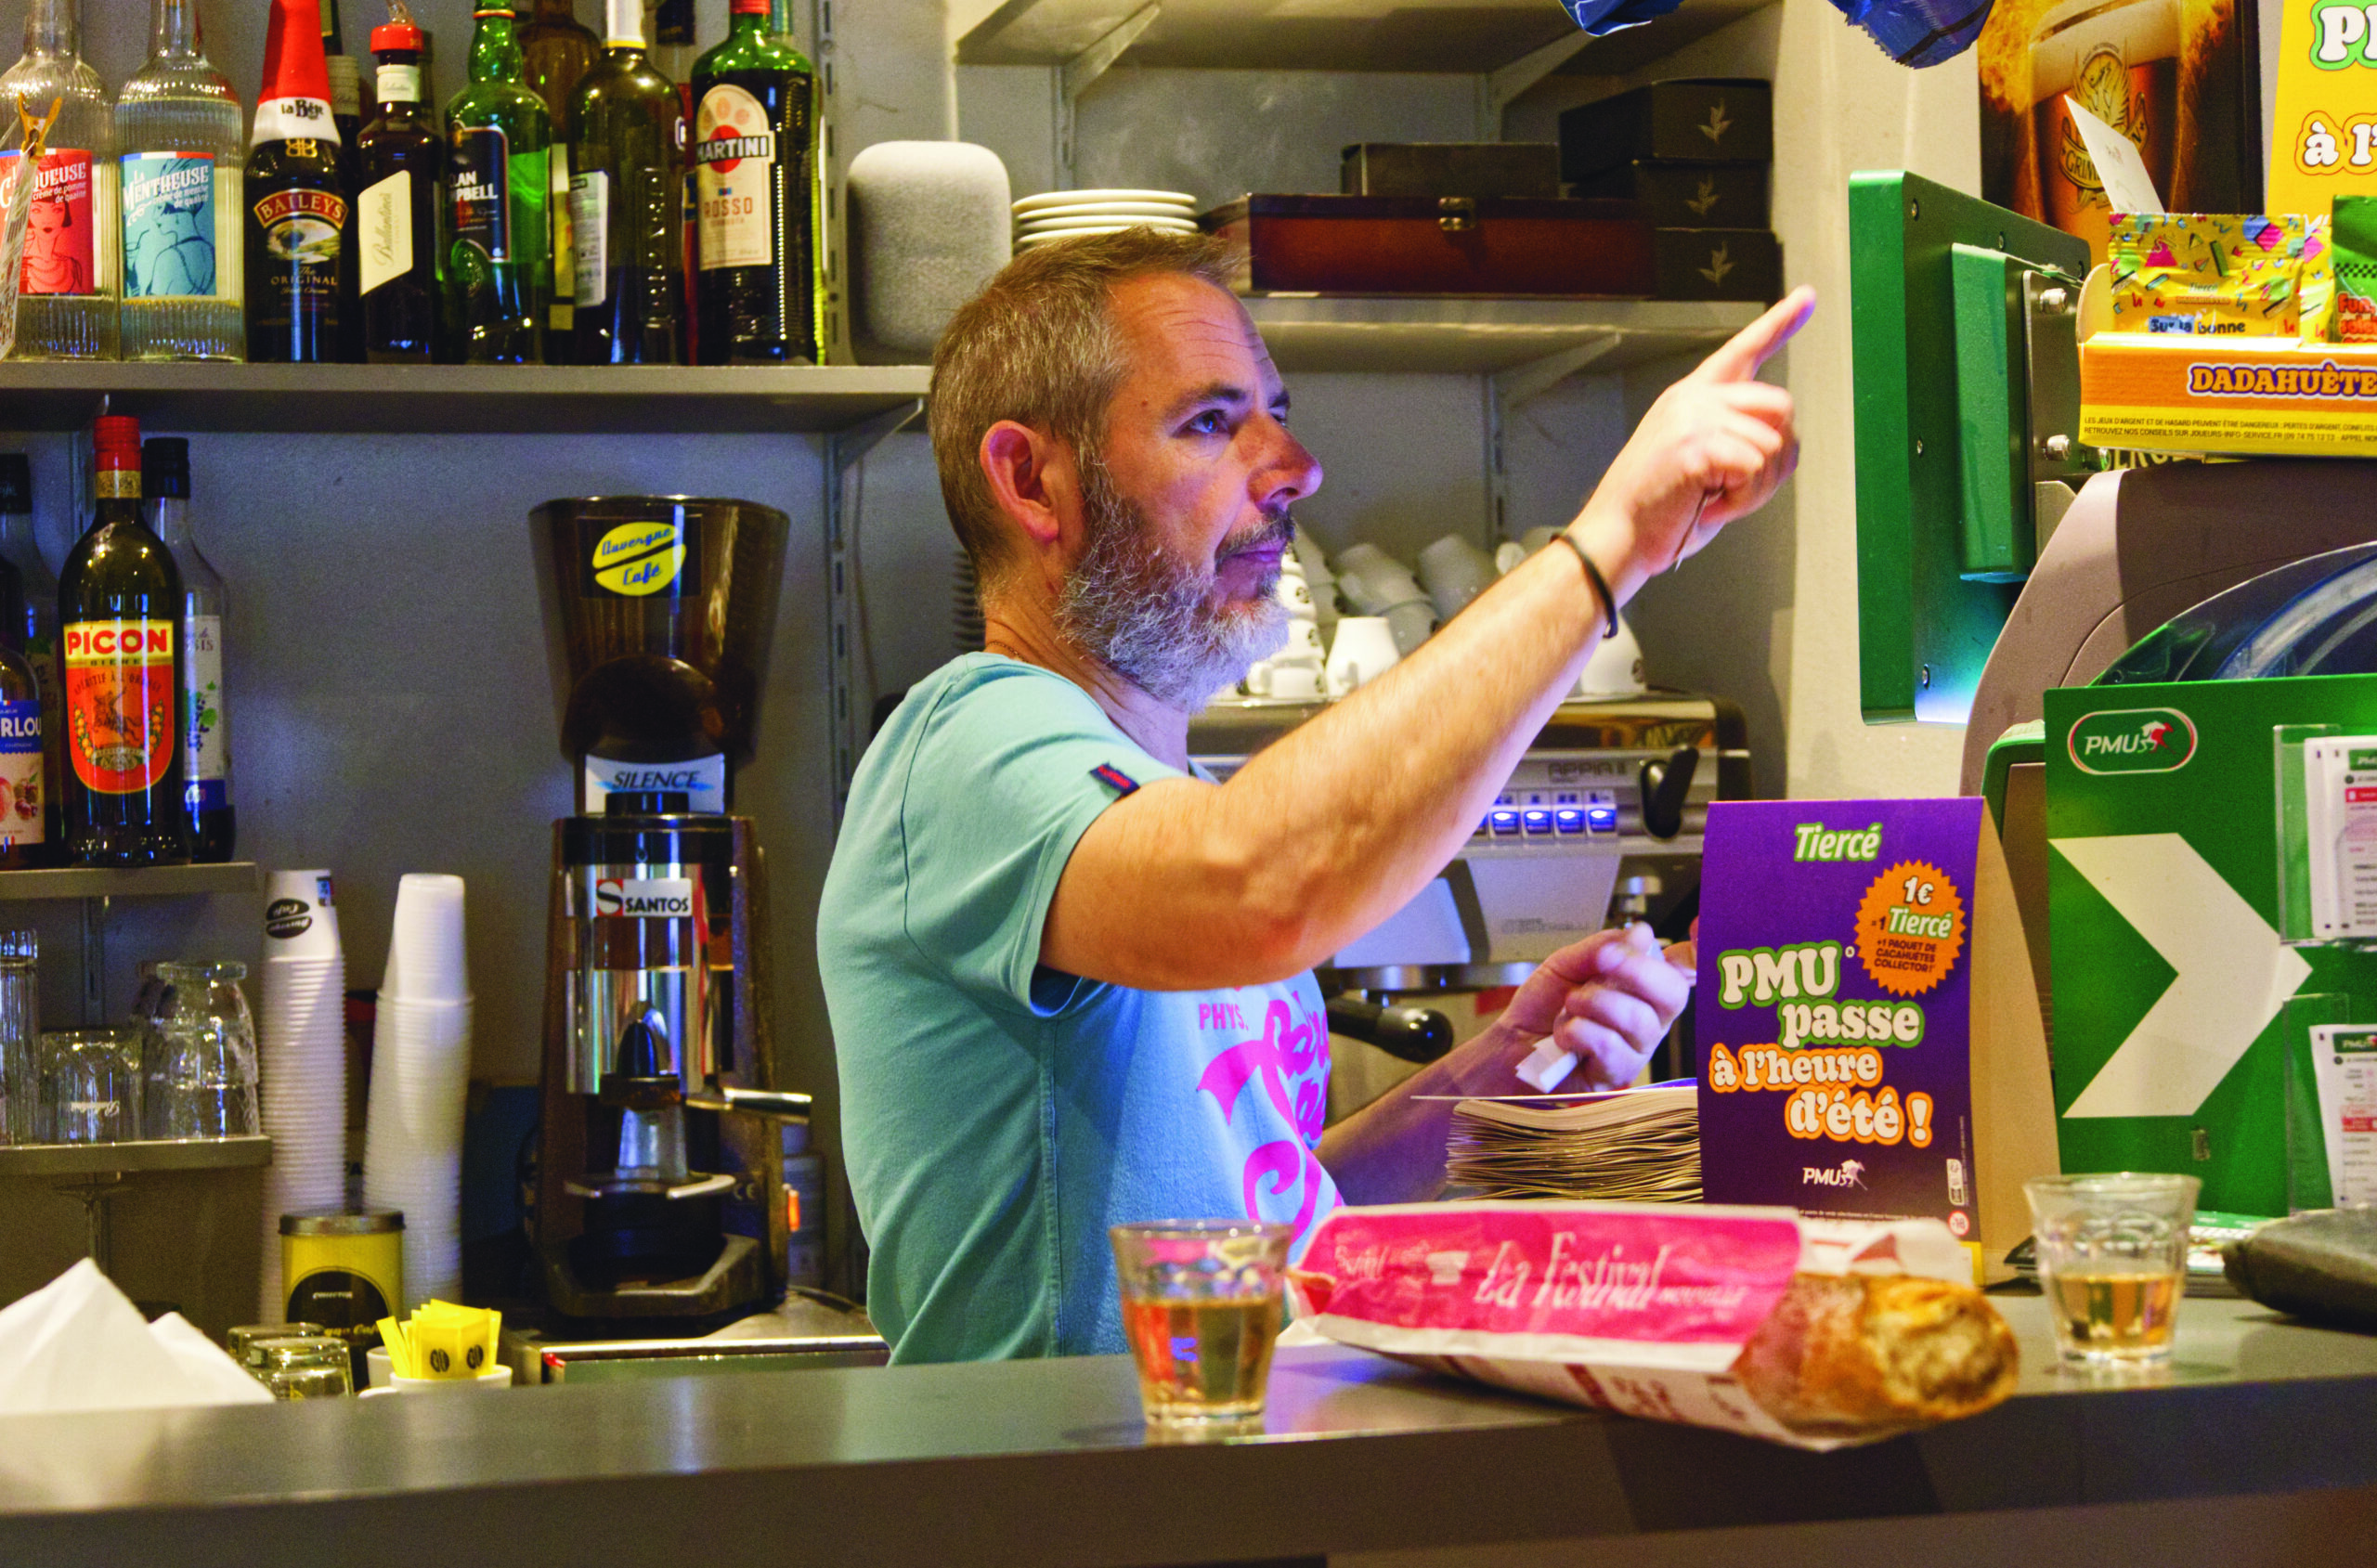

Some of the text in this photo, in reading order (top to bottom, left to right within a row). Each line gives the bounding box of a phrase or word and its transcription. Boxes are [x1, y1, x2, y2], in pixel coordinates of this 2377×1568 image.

[2304, 120, 2340, 166] à
[260, 194, 344, 220] BAILEYS
[704, 197, 753, 218] ROSSO
[602, 527, 670, 556] Auvergne
[68, 629, 167, 654] PICON
[2085, 734, 2141, 756] PMU
[613, 771, 699, 788] SILENCE
[1796, 823, 1880, 860] Tiercé
[1903, 876, 1934, 905] 1€
[626, 898, 688, 912] SANTOS
[1889, 907, 1952, 939] Tiercé
[1889, 940, 1923, 951] PAQUET
[1925, 943, 1936, 952] DE
[1722, 946, 1838, 1004] PMU
[1199, 1003, 1249, 1030] PHYS.
[1783, 1003, 1919, 1047] passe
[1713, 1050, 1877, 1086] à l'heure
[1789, 1090, 1900, 1139] d'été
[1802, 1167, 1841, 1186] PMU
